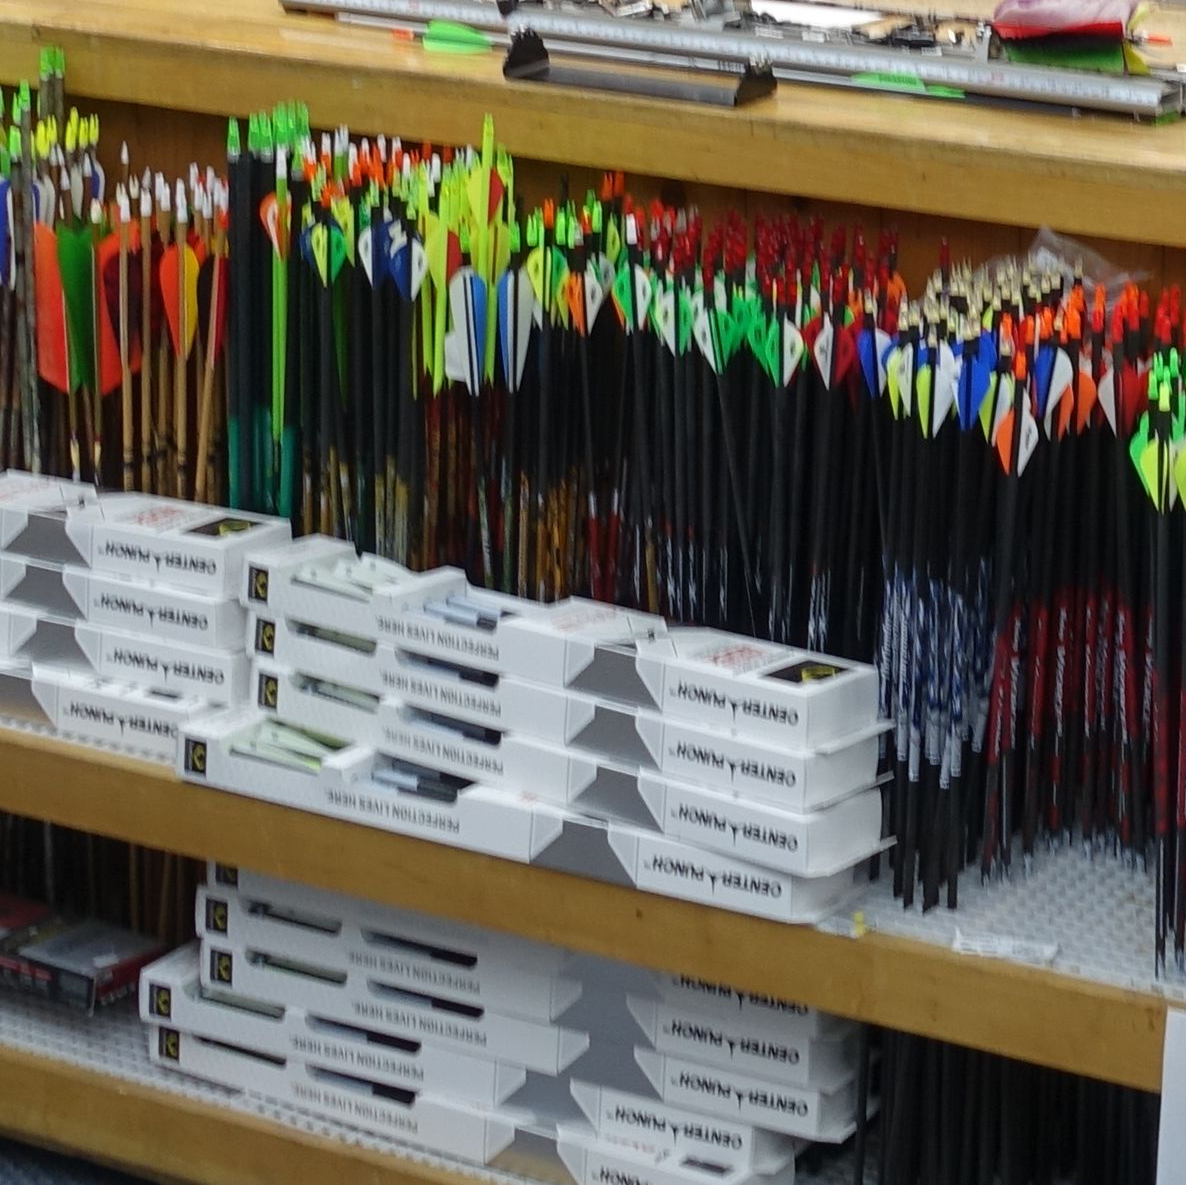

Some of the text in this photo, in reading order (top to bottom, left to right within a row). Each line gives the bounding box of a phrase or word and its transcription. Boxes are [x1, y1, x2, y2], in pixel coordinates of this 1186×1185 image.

[105, 539, 216, 576] CENTER PUNCH
[100, 594, 208, 631] CENTER PUNCH
[406, 624, 435, 645] LIVES
[437, 632, 499, 660] PERFECTION
[113, 648, 224, 687] CENTER PUNCH
[410, 680, 438, 702] LIVES
[440, 689, 501, 718] PERFECTION
[678, 682, 799, 725] CENTER PUNCH
[70, 702, 114, 728] PUNCH
[412, 737, 441, 759] LIVES
[442, 745, 503, 775] PERFECTION
[676, 741, 796, 785] CENTER PUNCH
[359, 797, 390, 820] LIVES
[393, 806, 460, 834] PERFECTION
[678, 804, 798, 849] CENTER PUNCH
[652, 854, 782, 896] CENTER PUNCH
[380, 958, 411, 976] LIVES
[414, 965, 480, 995] PERFECTION
[386, 1009, 417, 1027] LIVES
[419, 1018, 487, 1046] PERFECTION
[324, 1040, 354, 1060] LIVES
[671, 1020, 800, 1065] CENTER PUNCH
[357, 1052, 424, 1080] PERFECTION
[323, 1094, 352, 1114] LIVES
[680, 1071, 808, 1118] CENTER PUNCH
[354, 1101, 418, 1134] PERFECTION
[615, 1107, 743, 1151] CENTER PUNCH
